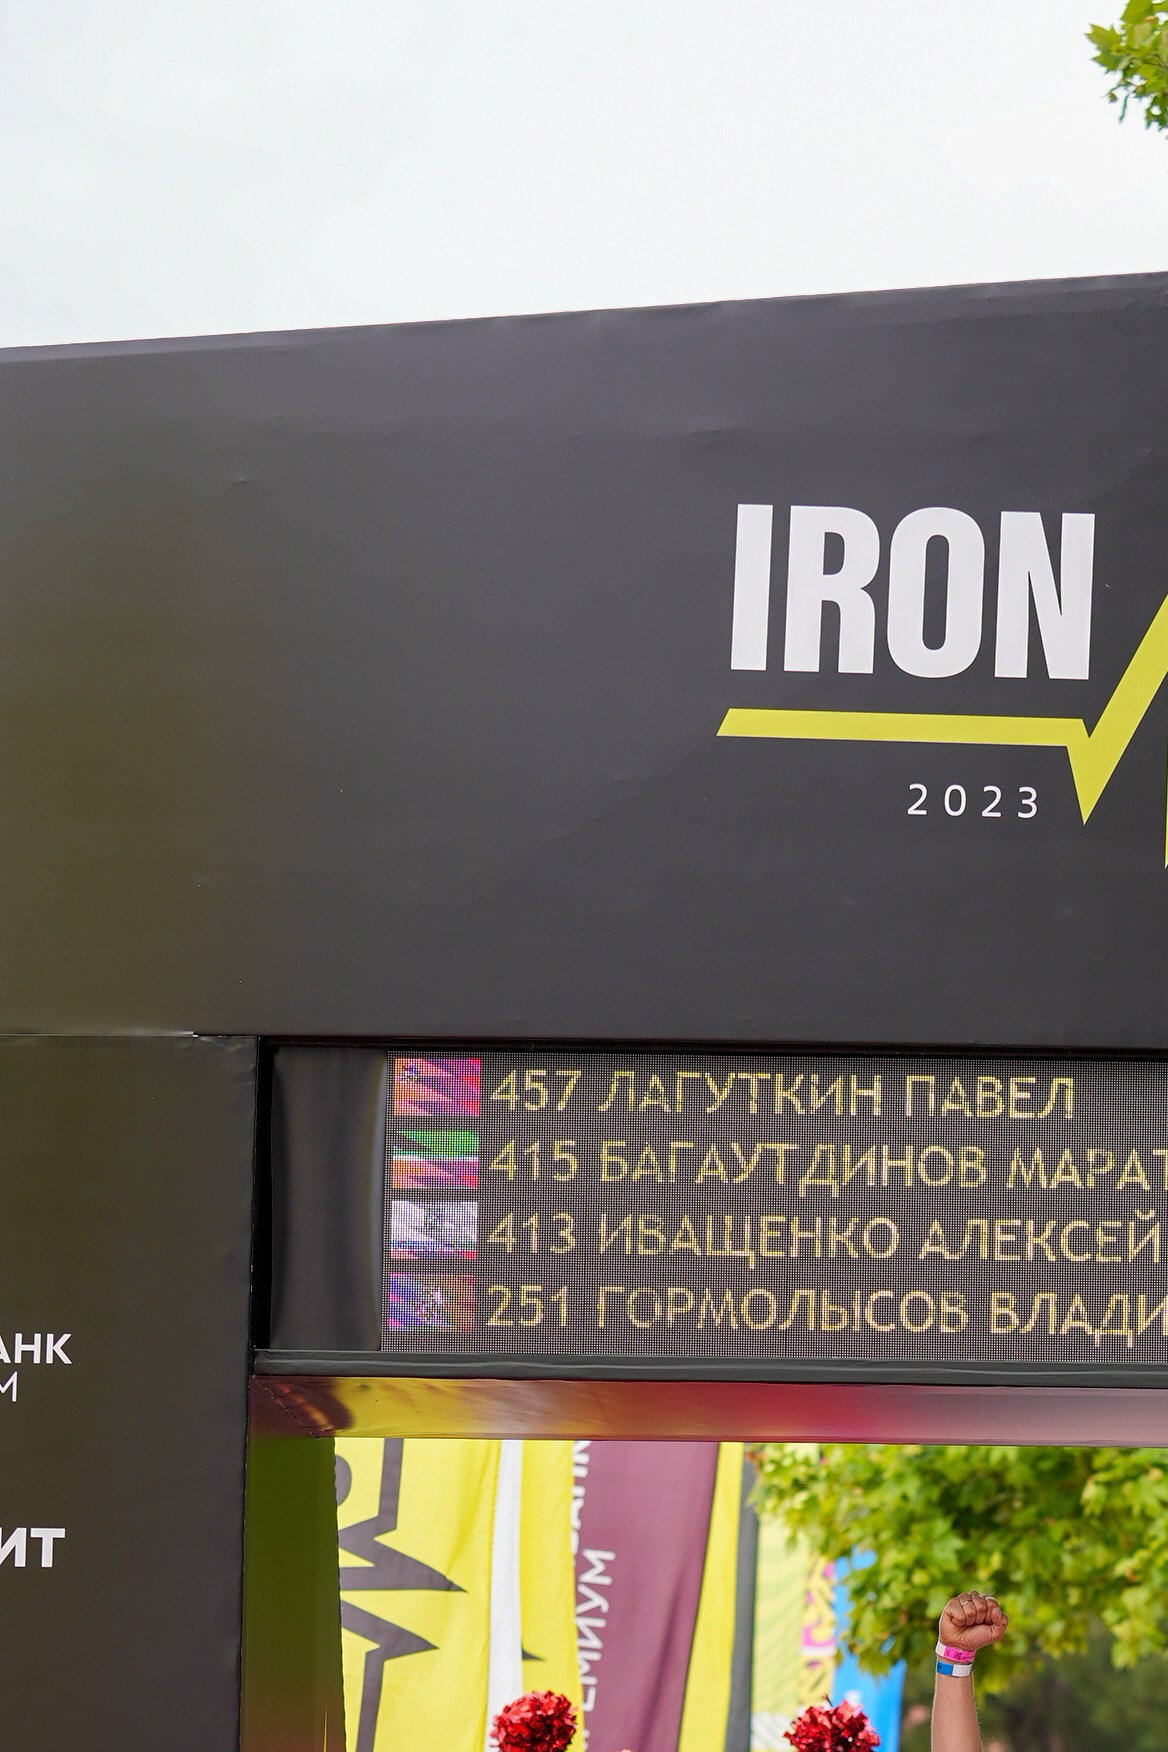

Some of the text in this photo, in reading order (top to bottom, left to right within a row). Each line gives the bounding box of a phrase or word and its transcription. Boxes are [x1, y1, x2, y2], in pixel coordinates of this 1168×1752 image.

[730, 503, 1097, 681] IRON
[907, 783, 1041, 820] 2023
[490, 1071, 583, 1112] 457
[600, 1071, 882, 1118] ЛАГУТКИН
[905, 1077, 1075, 1120] ПАВЕЛ
[489, 1140, 580, 1182] 415
[600, 1141, 988, 1198] БАГАУТДИНОВ
[486, 1211, 577, 1255] 413
[600, 1214, 897, 1269] ИВАЩЕНКО
[918, 1210, 1163, 1263] АЛЕКСЕЙ
[485, 1285, 570, 1328] 251
[600, 1286, 970, 1333] ГОРМОЛЫСОВ
